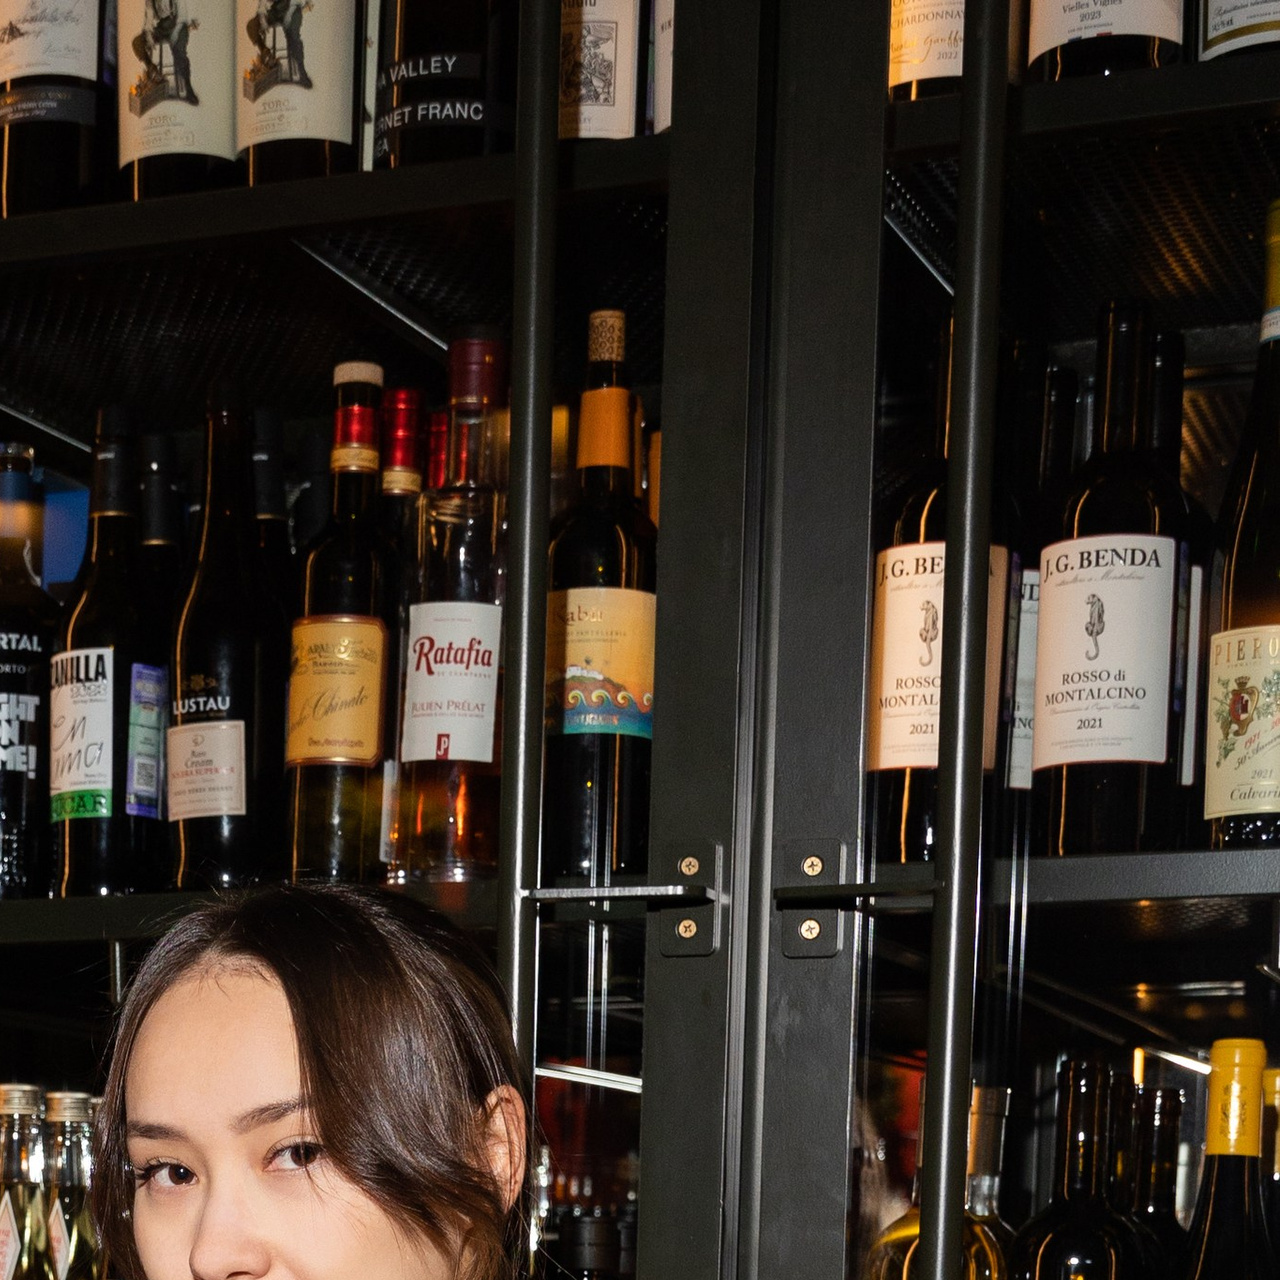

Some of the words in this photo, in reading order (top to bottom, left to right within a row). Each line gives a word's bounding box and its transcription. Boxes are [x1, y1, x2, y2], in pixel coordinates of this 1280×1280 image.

[1079, 10, 1102, 23] 2023
[389, 54, 457, 83] VALLEY
[417, 101, 484, 121] FRANC
[1079, 547, 1162, 571] BENDA
[412, 635, 493, 677] Ratafia
[1214, 636, 1280, 666] PIERO
[1061, 670, 1111, 686] ROSSO
[1114, 669, 1126, 682] di
[172, 695, 231, 715] LUSTAU
[879, 692, 938, 711] MONTAL
[1044, 687, 1147, 708] MONTALCINO
[909, 723, 935, 735] 2021
[1076, 718, 1104, 731] 2021
